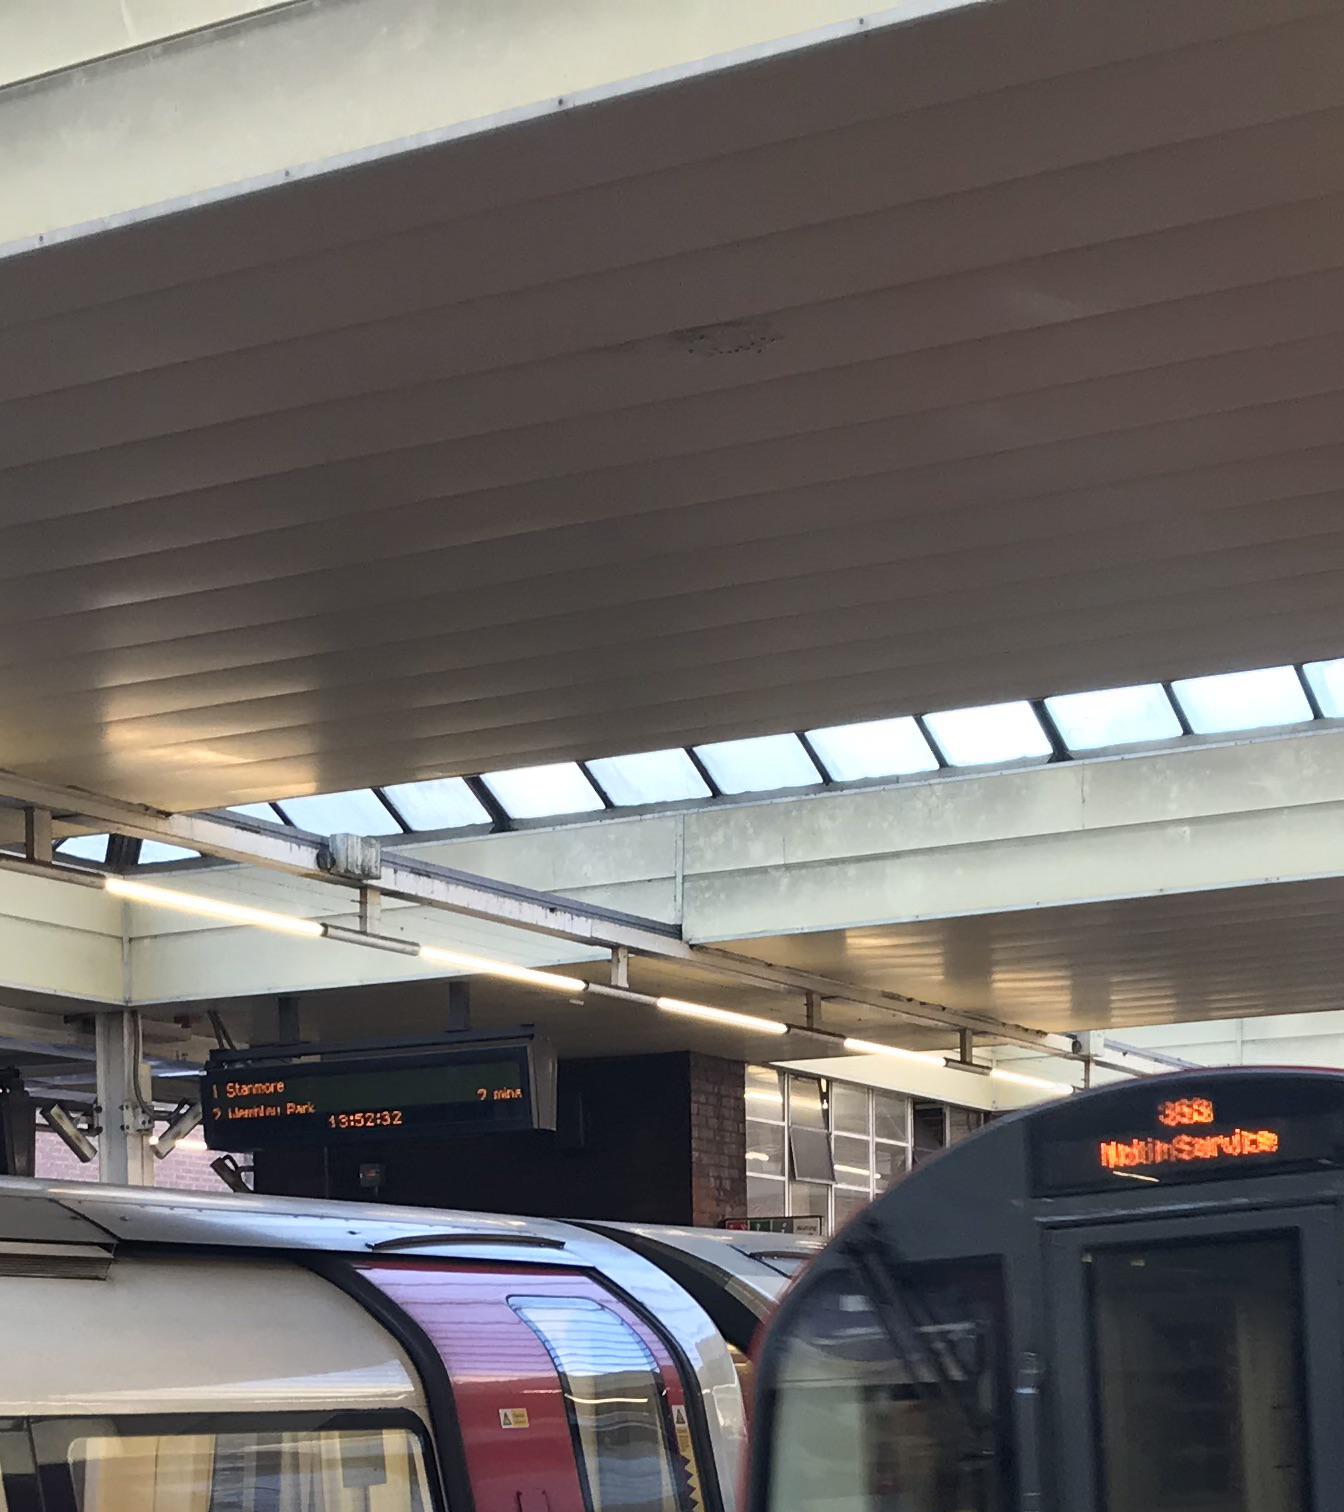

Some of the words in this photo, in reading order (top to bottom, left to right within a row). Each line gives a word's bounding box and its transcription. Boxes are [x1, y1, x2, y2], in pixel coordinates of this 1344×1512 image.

[226, 1080, 286, 1098] Stanmore
[286, 1101, 316, 1117] Park
[493, 1086, 523, 1101] mins
[327, 1110, 403, 1129] 13:52:32
